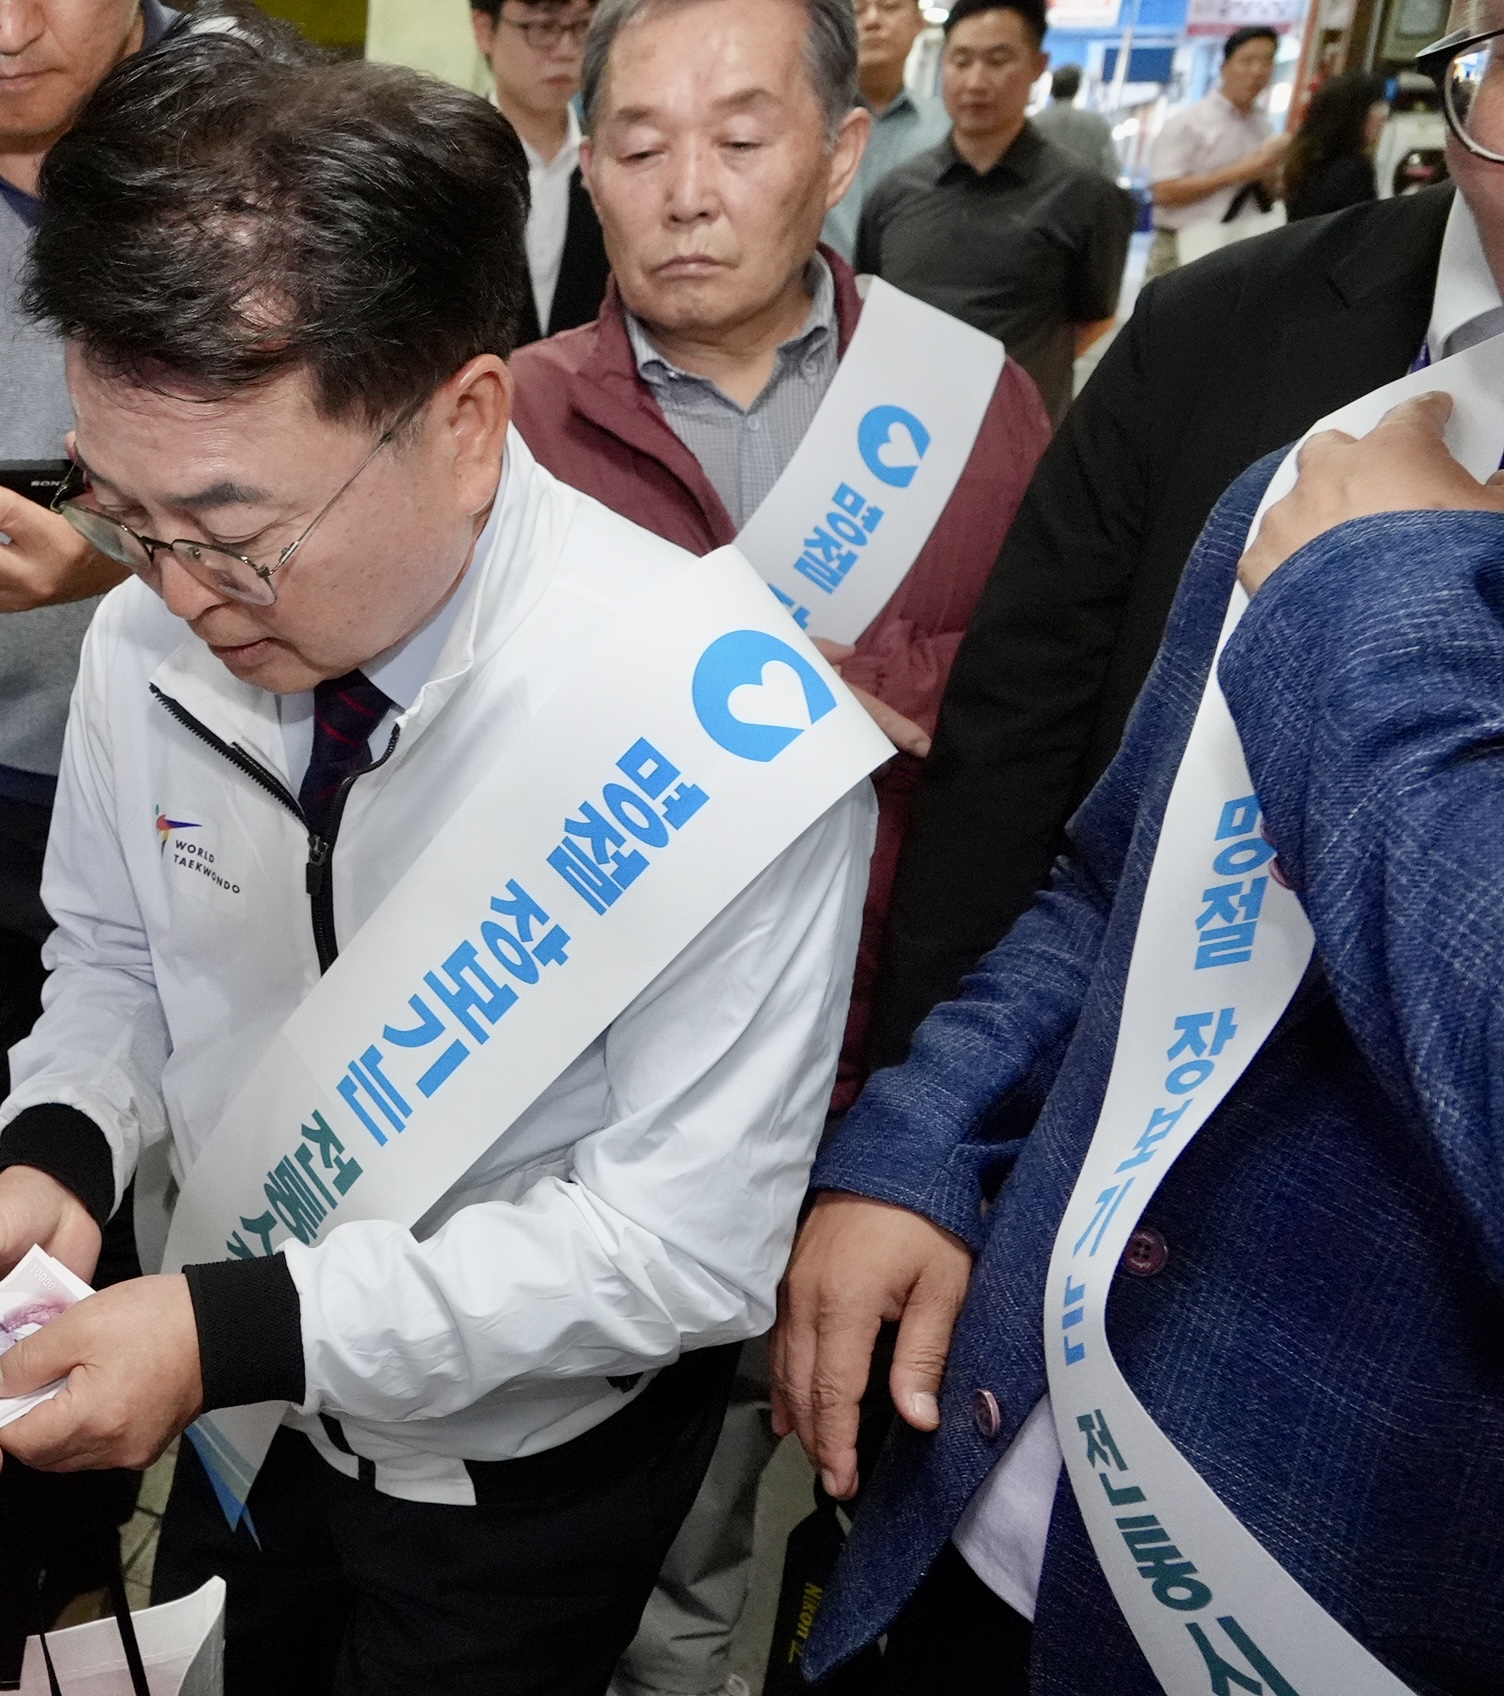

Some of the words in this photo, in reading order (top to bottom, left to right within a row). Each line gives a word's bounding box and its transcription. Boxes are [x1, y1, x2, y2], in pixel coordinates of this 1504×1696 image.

[793, 482, 885, 595] 명절
[173, 854, 241, 894] TAEKWONDO
[175, 839, 215, 864] WORLD
[546, 736, 710, 916] 명절
[336, 878, 572, 1148] 장보기는
[224, 1109, 364, 1261] 전통
[1062, 1007, 1238, 1366] 장보기는
[29, 1263, 58, 1292] 10000
[796, 1582, 824, 1640] Nikon
